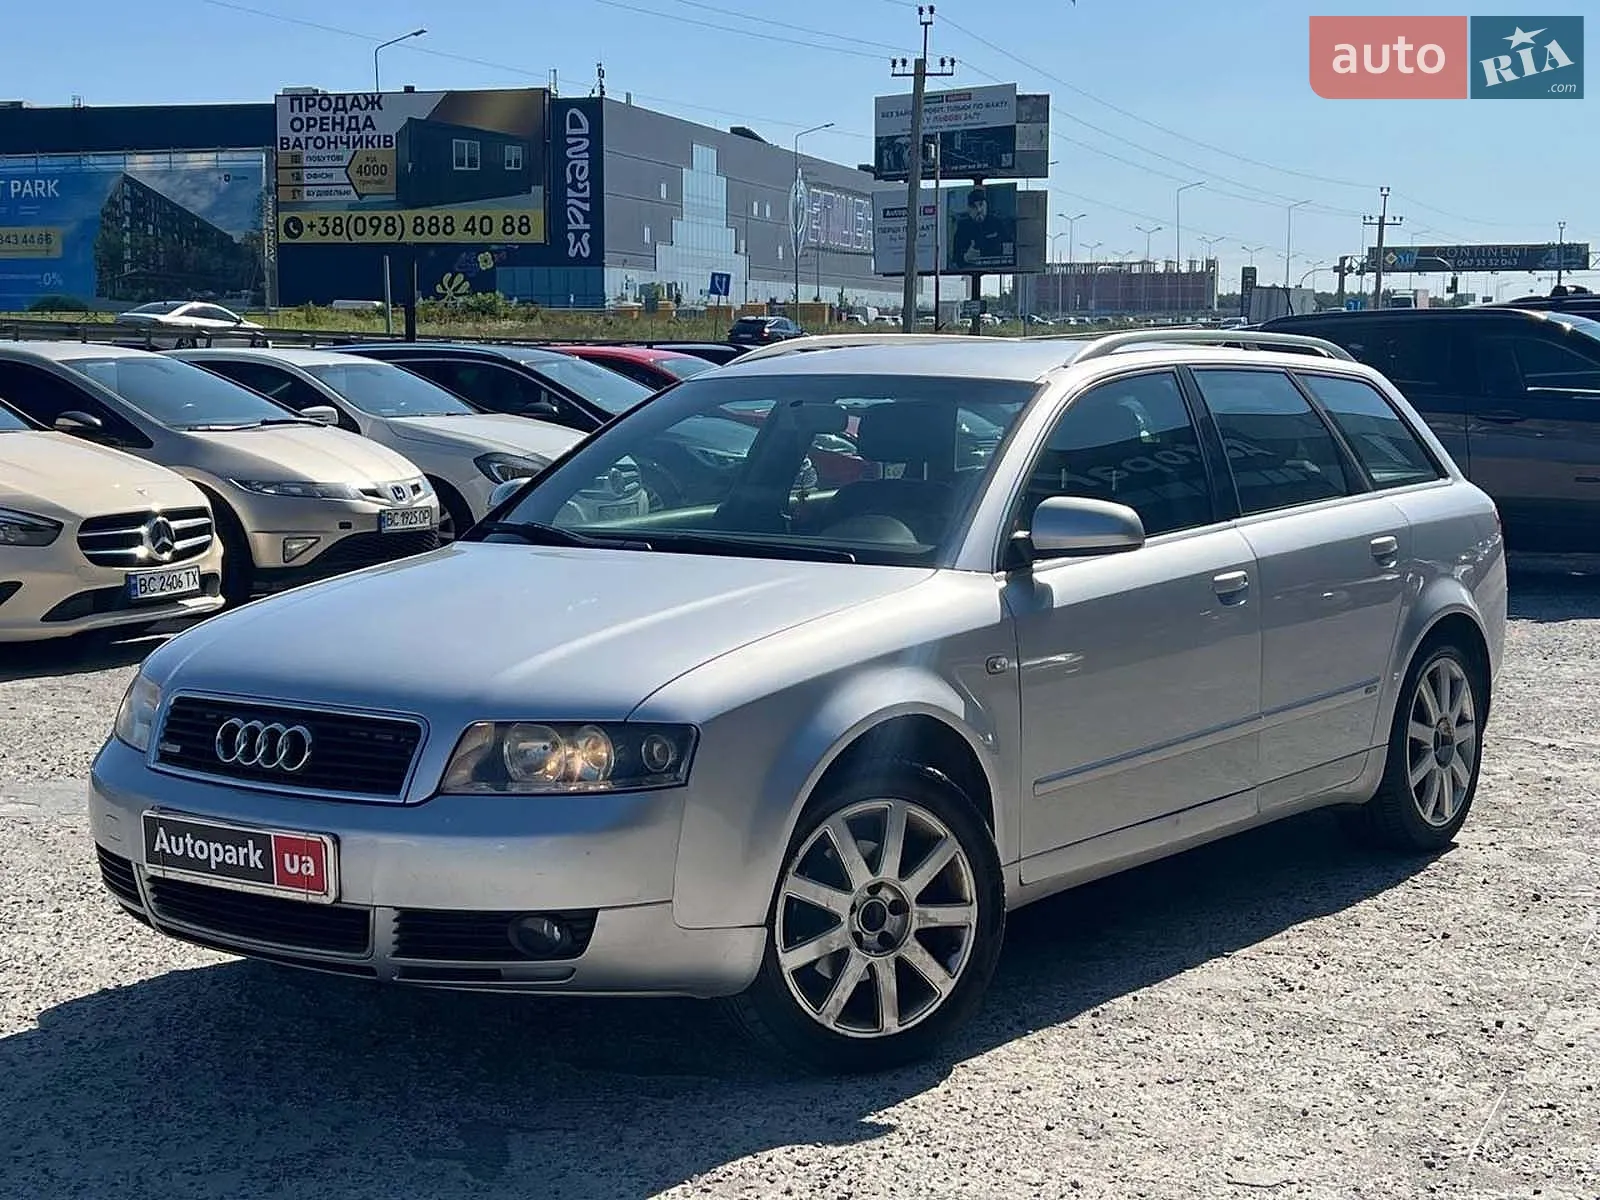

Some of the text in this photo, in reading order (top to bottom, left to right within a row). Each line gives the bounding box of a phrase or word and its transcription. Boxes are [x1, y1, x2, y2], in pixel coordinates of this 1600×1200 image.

[289, 94, 384, 114] ПРОДАЖ
[289, 116, 376, 135] ОРЕНДА
[279, 135, 394, 151] ВАГОНЧИКІВ
[356, 164, 387, 177] 4000
[9, 178, 60, 200] PARK
[307, 213, 531, 240] +38(098) 888 40 88
[1434, 246, 1529, 258] CONTINENT
[139, 570, 199, 594] BC 2406 TX
[153, 826, 315, 877] Autopark ua
